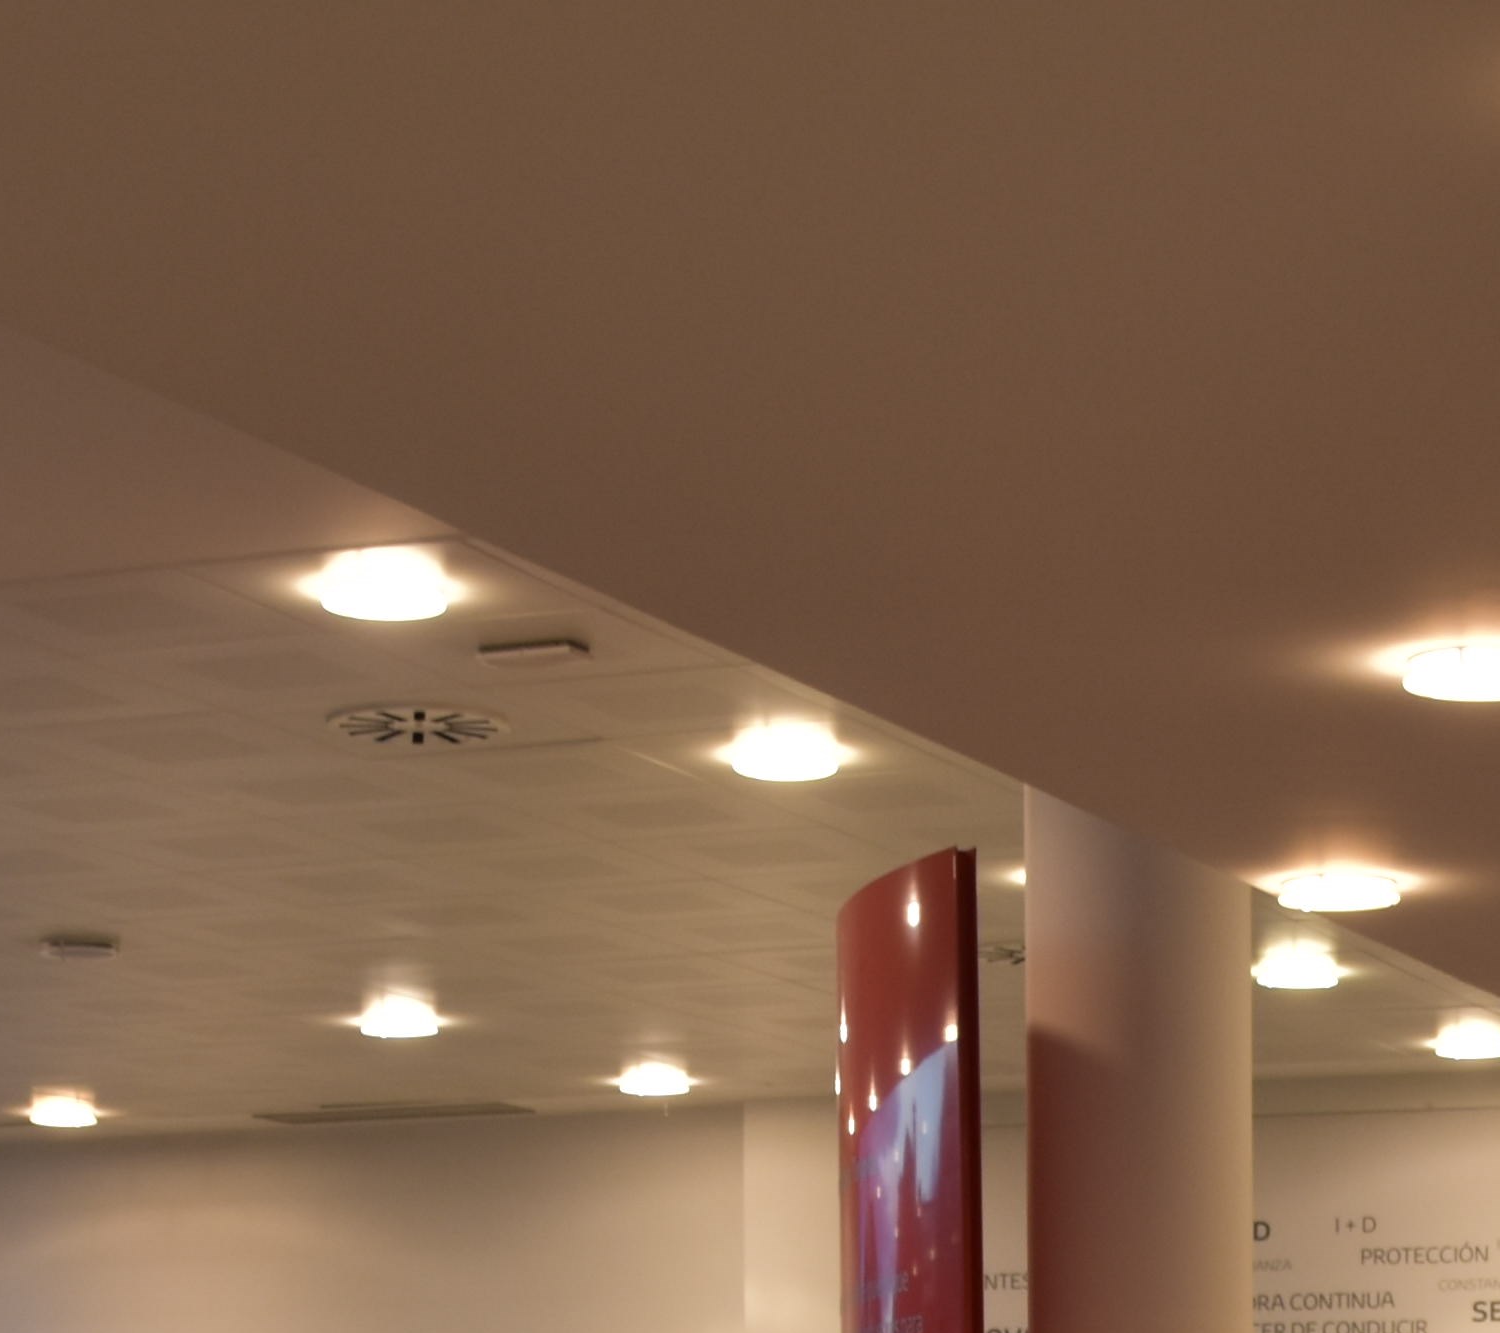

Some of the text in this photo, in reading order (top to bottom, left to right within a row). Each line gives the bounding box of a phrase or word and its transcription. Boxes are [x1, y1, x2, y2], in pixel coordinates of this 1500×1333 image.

[1360, 1242, 1489, 1266] PROTECCIÓN
[1253, 1290, 1396, 1311] RA CONTINUA
